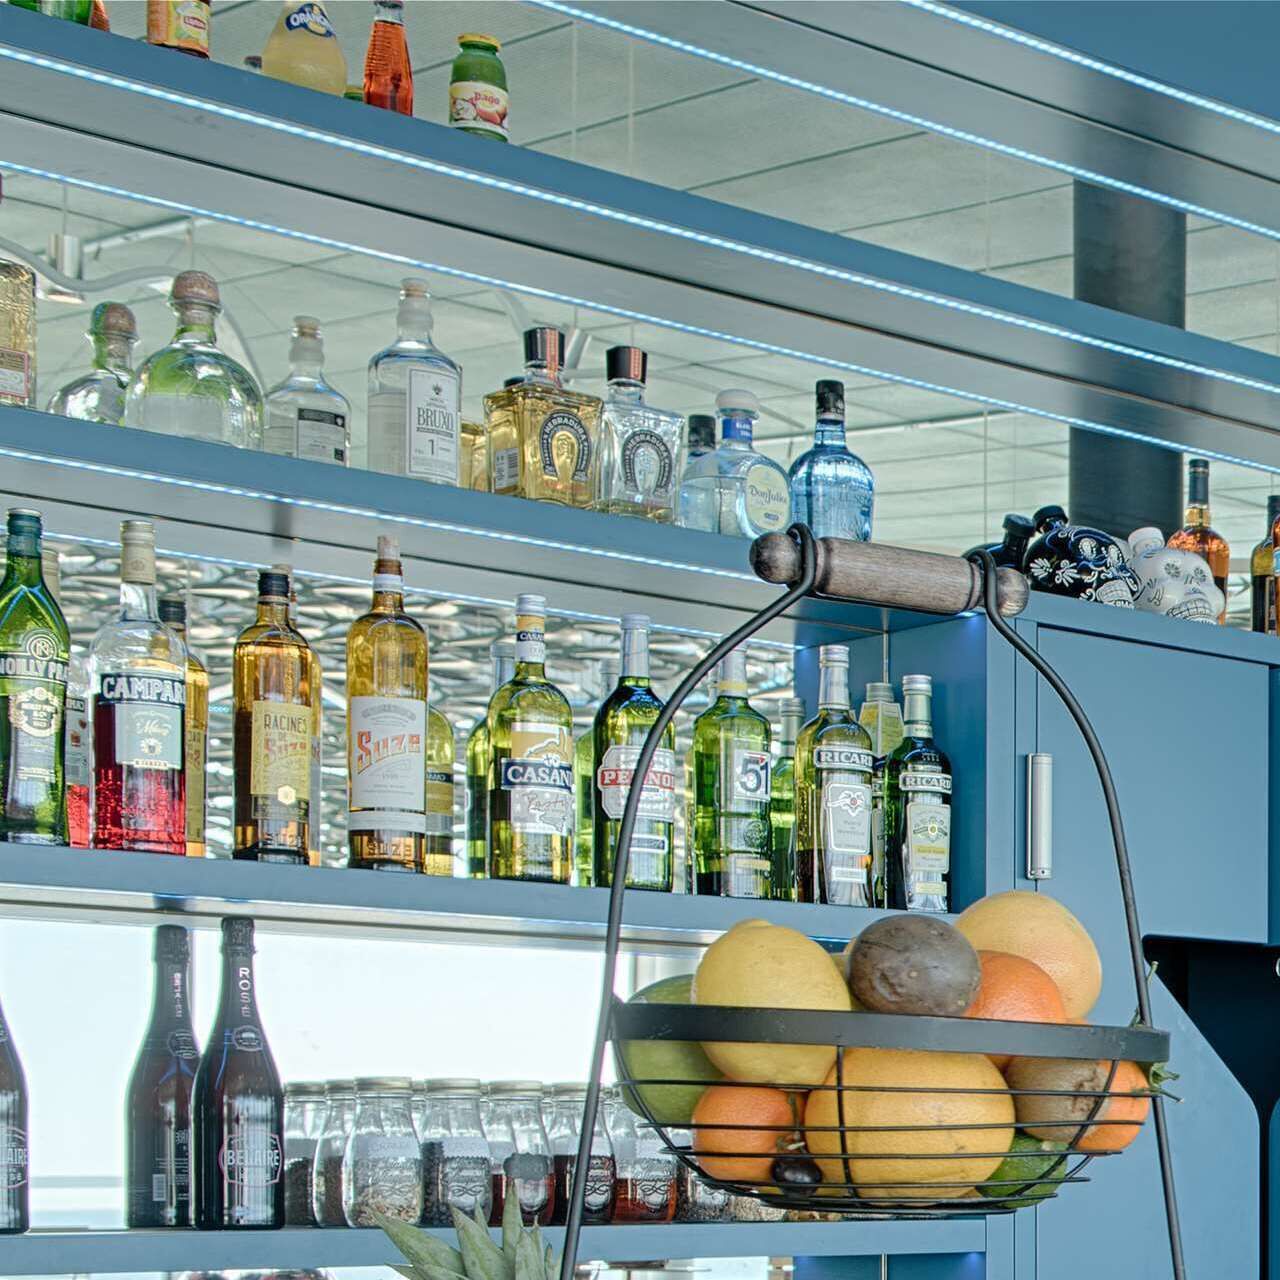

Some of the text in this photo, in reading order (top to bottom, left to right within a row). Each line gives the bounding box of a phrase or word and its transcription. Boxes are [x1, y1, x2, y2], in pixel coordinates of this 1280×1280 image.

[102, 677, 185, 704] CAMPAR
[263, 713, 308, 734] RACINES
[507, 765, 572, 789] CASAN
[603, 769, 674, 789] PENO
